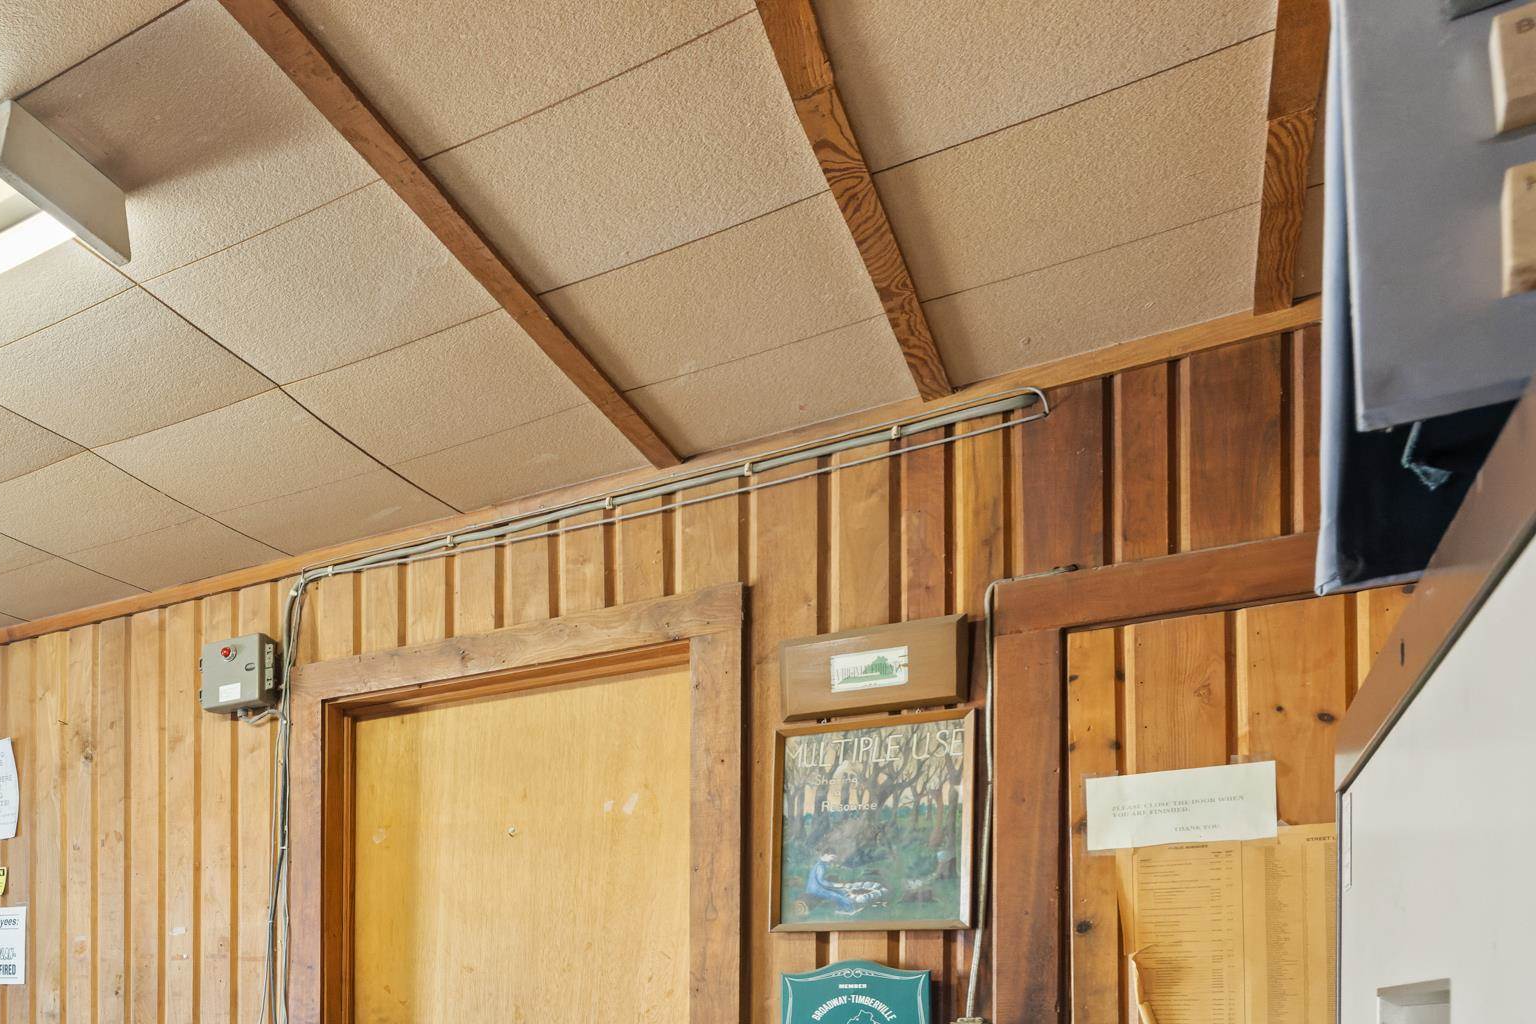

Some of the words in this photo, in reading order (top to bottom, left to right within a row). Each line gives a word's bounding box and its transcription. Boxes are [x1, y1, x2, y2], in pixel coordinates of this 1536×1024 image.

[786, 734, 904, 768] MULTIPLE
[912, 728, 964, 760] USE
[0, 964, 16, 976] FIRED
[811, 994, 897, 1021] BROADWAY-TIMBERVILLE
